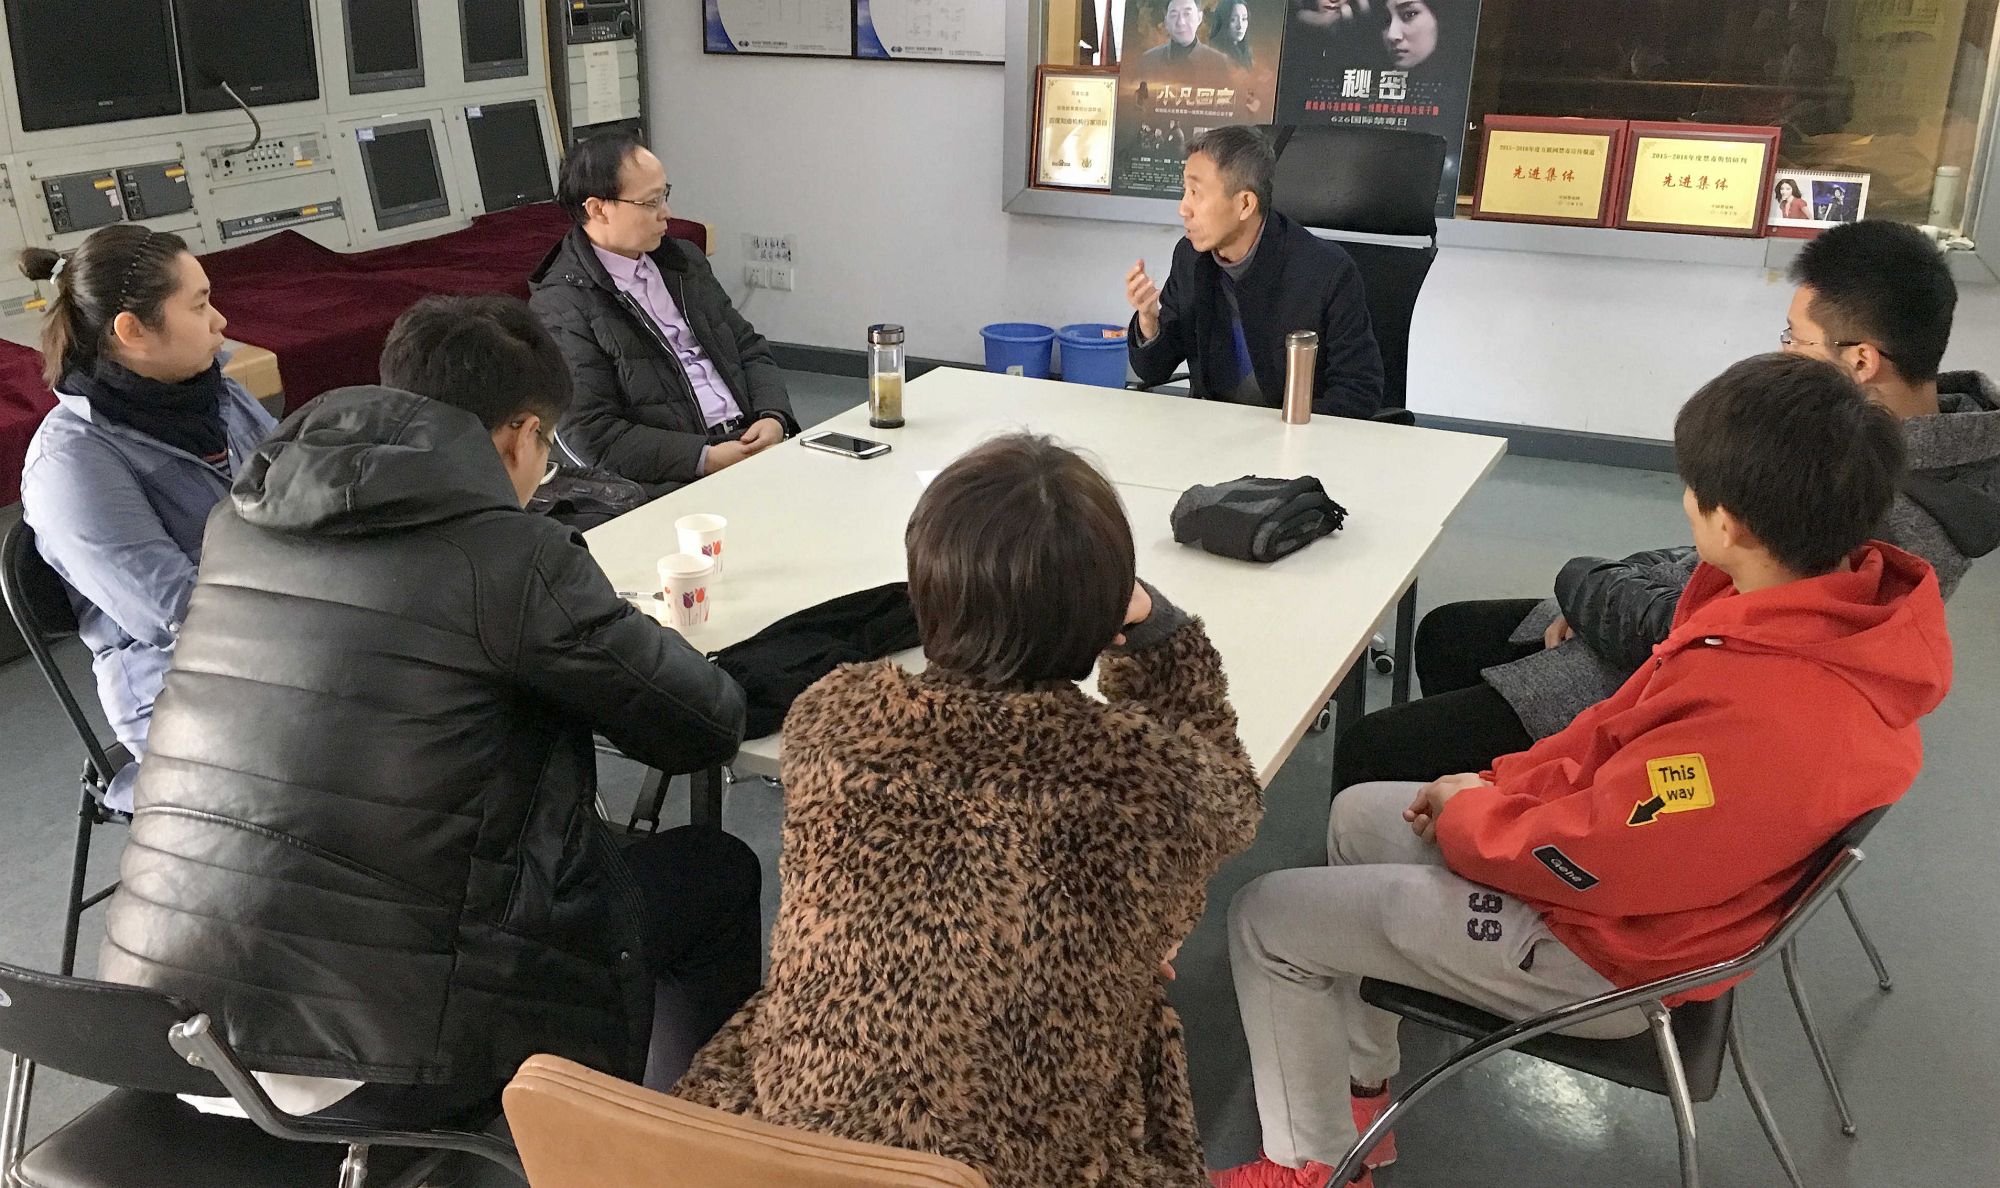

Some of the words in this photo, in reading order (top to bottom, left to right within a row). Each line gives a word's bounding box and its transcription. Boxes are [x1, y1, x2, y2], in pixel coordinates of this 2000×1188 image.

[1341, 69, 1409, 100] 秘密
[1330, 115, 1408, 126] 626国际禁毒日
[1513, 165, 1575, 183] 先进集体
[1662, 172, 1729, 191] 先进集体
[1658, 764, 1696, 783] This
[1666, 786, 1695, 801] way
